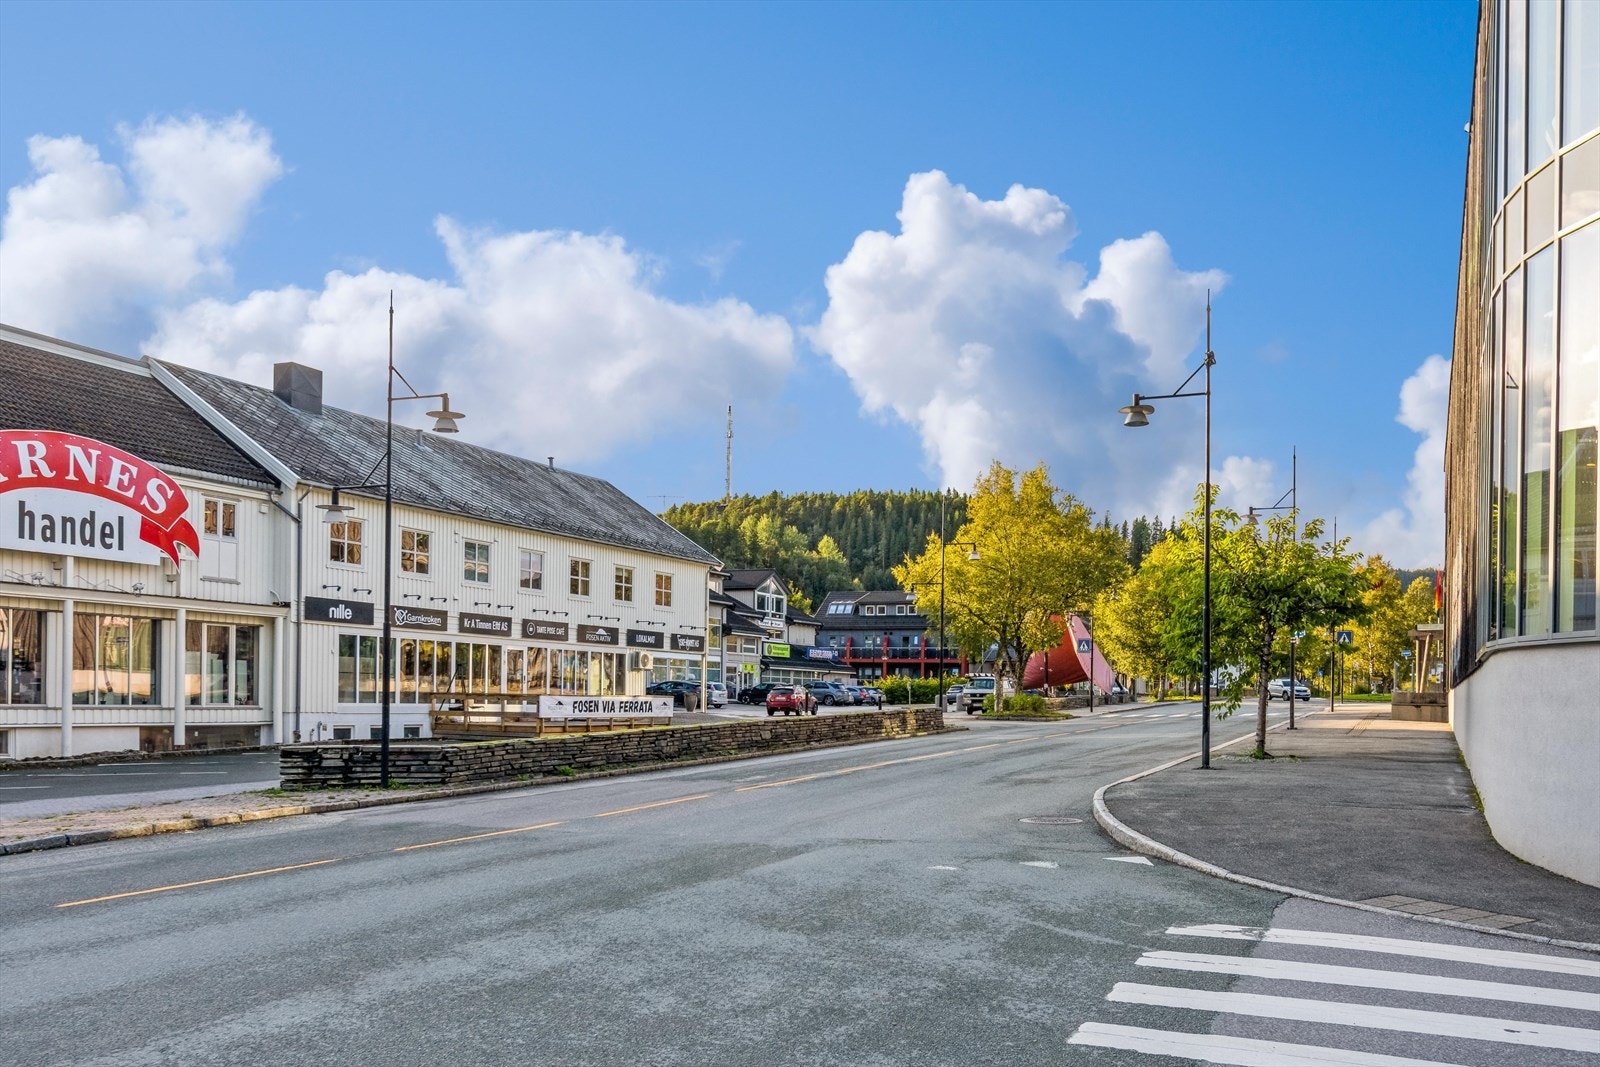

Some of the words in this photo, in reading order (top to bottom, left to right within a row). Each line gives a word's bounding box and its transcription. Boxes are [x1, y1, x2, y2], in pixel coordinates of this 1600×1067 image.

[0, 440, 175, 514] RNES
[18, 500, 124, 551] handel
[329, 604, 352, 620] nille
[407, 613, 442, 624] Garnkroken
[464, 618, 471, 627] Kr
[471, 618, 476, 628] A
[501, 621, 508, 631] AS
[536, 626, 547, 634] TANTE
[547, 626, 556, 635] POSE
[556, 626, 565, 635] CAFÉ
[585, 633, 599, 641] FOSEN
[572, 700, 599, 713] FOSEN
[601, 700, 616, 713] VIA
[618, 701, 653, 713] FERRATA
